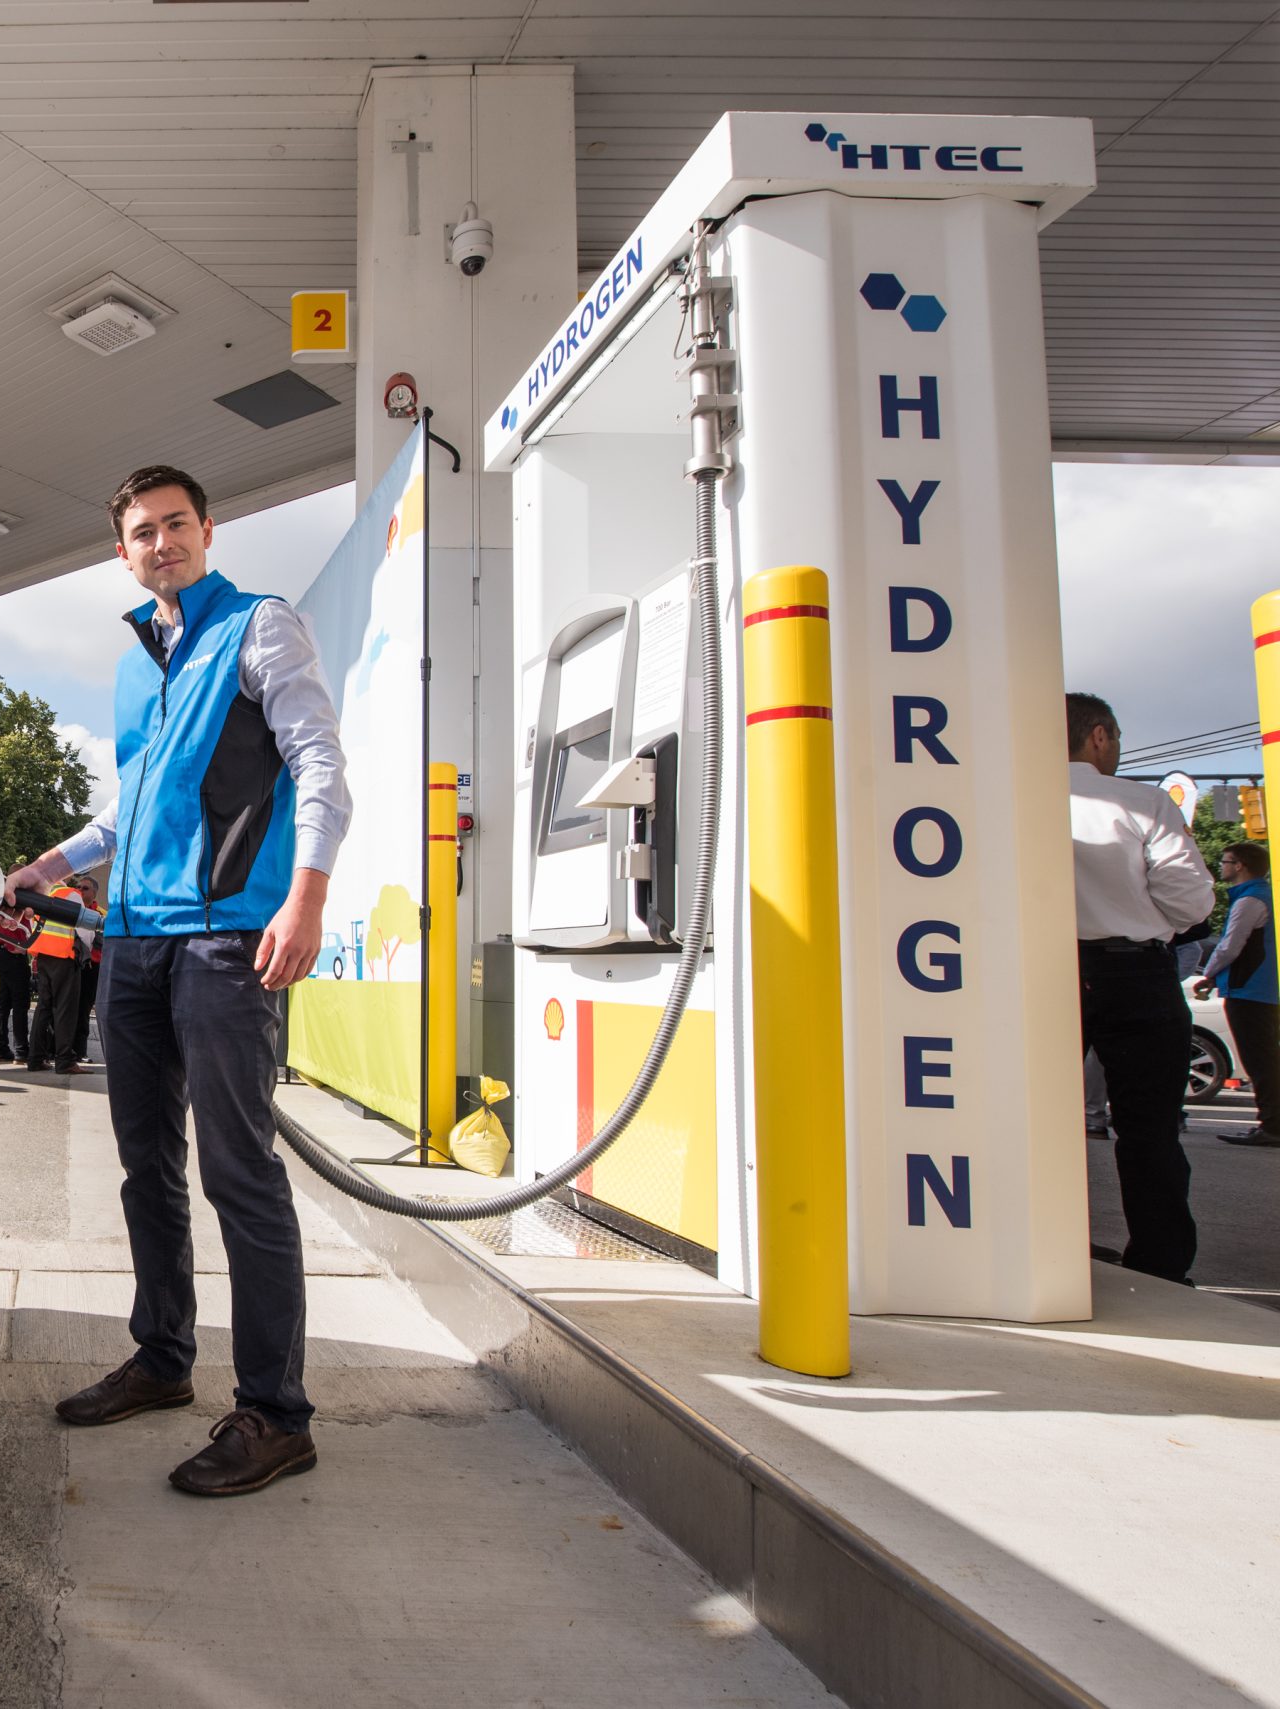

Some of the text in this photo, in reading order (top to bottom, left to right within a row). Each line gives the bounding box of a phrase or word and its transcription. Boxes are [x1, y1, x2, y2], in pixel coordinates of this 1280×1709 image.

[842, 144, 1024, 172] HTEC
[313, 309, 332, 331] 2
[526, 236, 645, 407] HYDROGEN
[877, 375, 972, 1228] HYDROGEN
